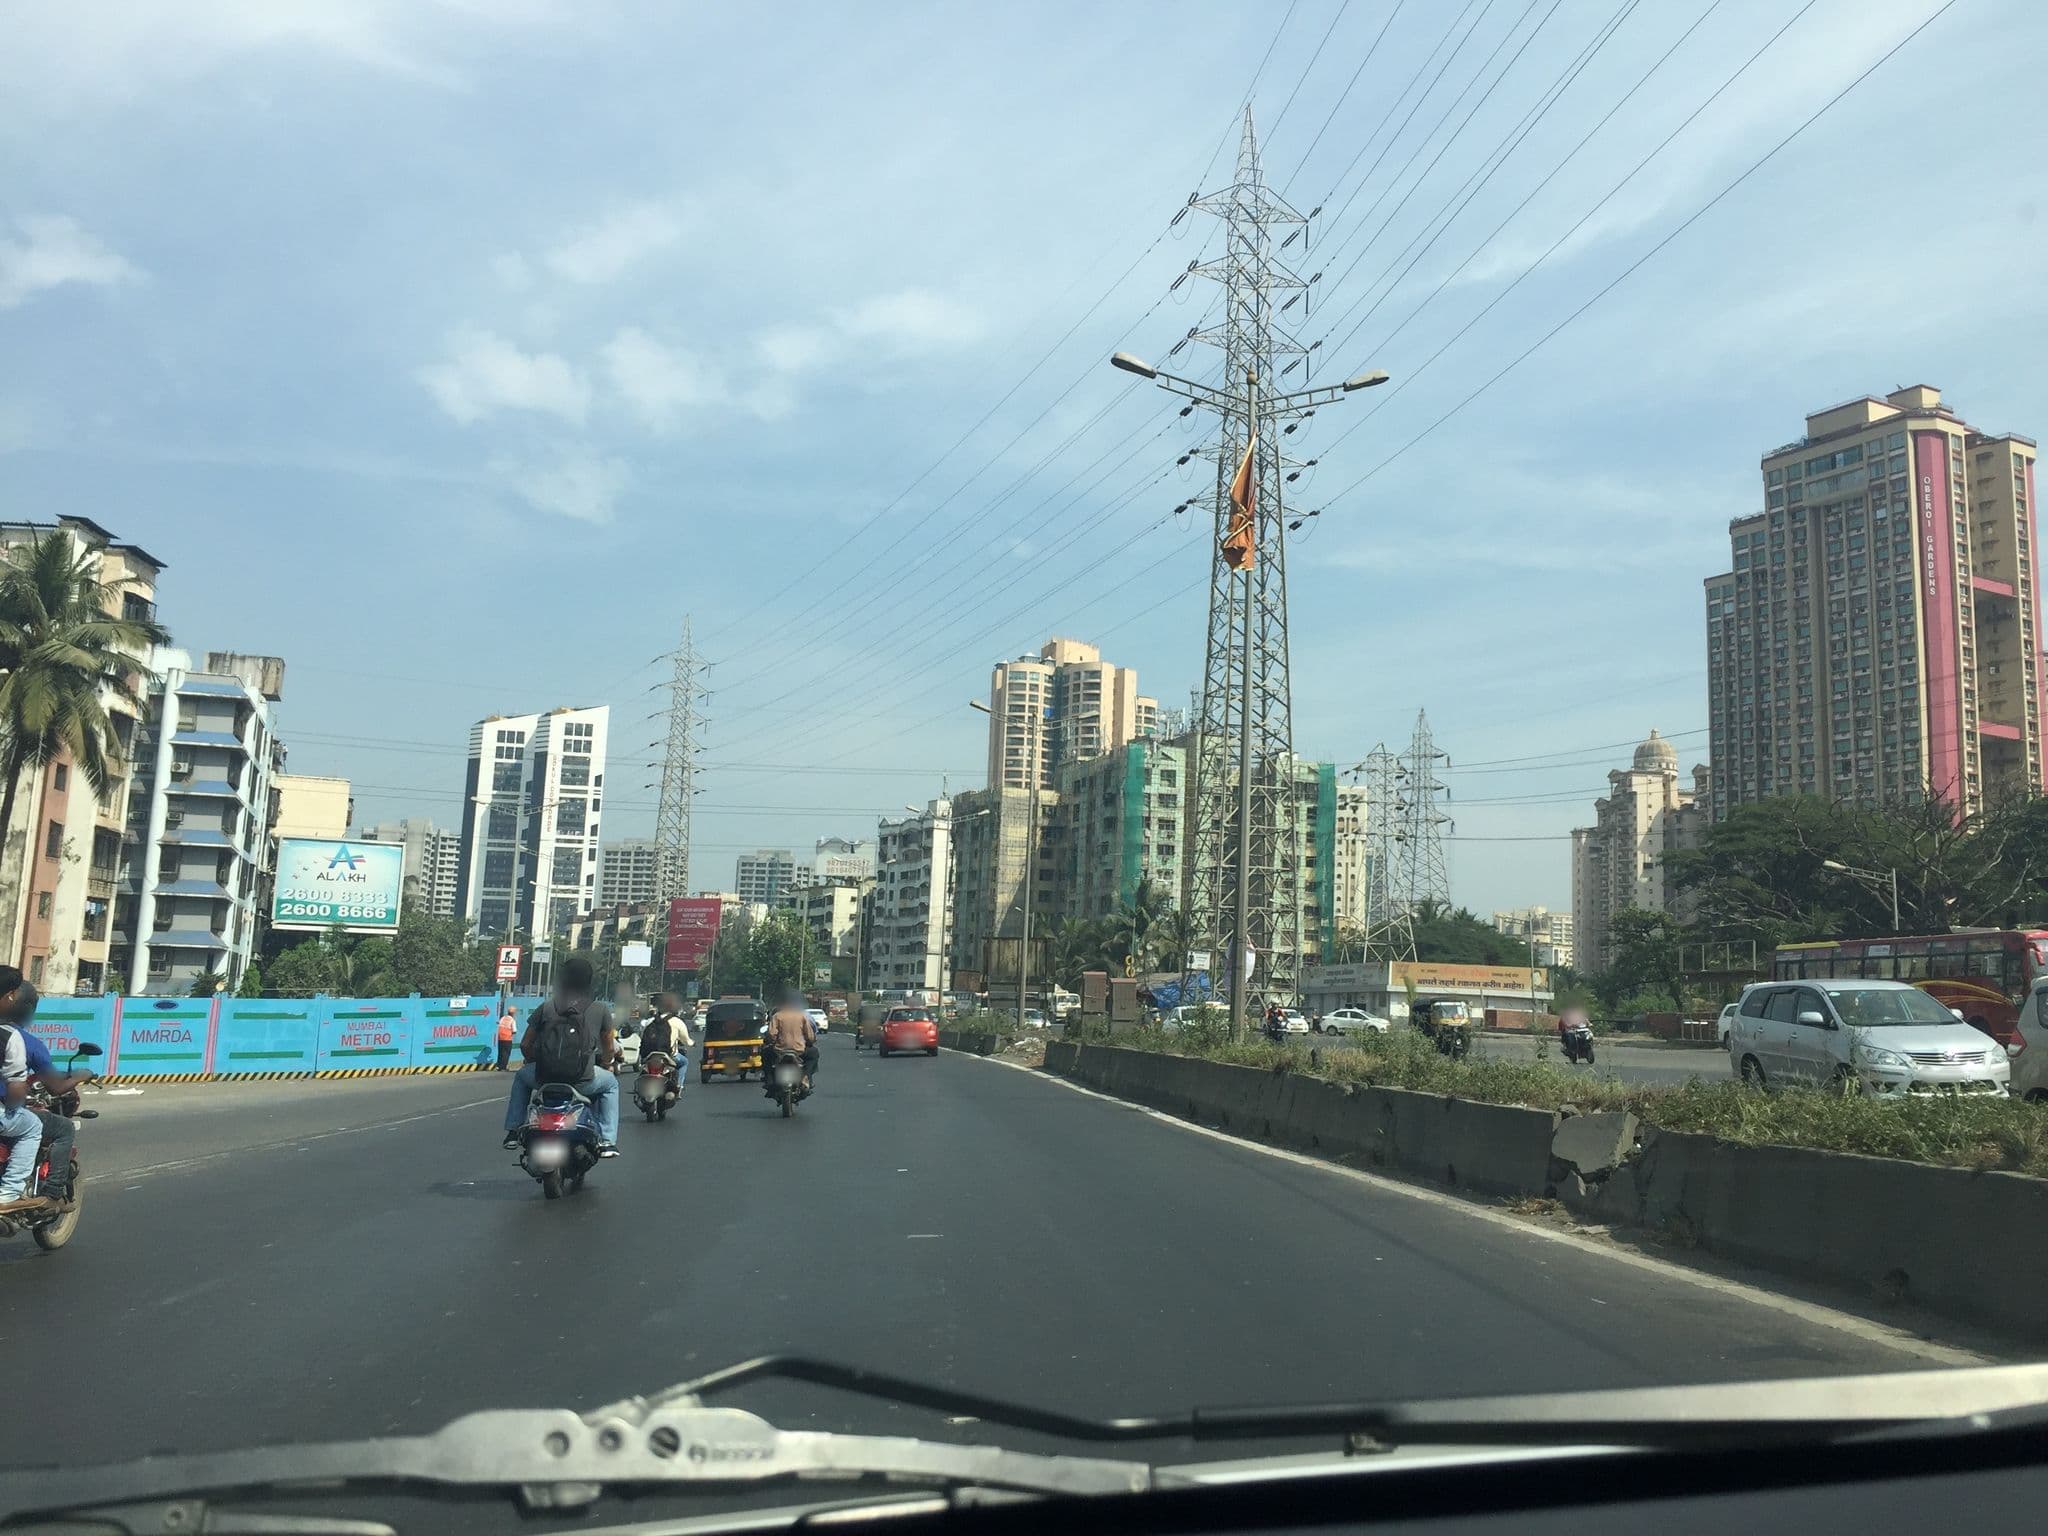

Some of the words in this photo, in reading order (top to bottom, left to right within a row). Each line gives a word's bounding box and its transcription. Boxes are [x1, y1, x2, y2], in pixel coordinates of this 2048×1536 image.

[1923, 477, 1932, 527] OBEROI
[1927, 535, 1936, 595] GARDENS
[316, 871, 366, 882] ALAKH
[284, 888, 332, 901] 2600
[280, 902, 331, 916] 2600
[337, 905, 387, 919] 8666
[347, 1021, 386, 1031] MUMBAI
[433, 1025, 476, 1038] MMRDA
[131, 1029, 192, 1043] MMRDA
[341, 1033, 391, 1046] METRO
[37, 1037, 79, 1050] TRO
